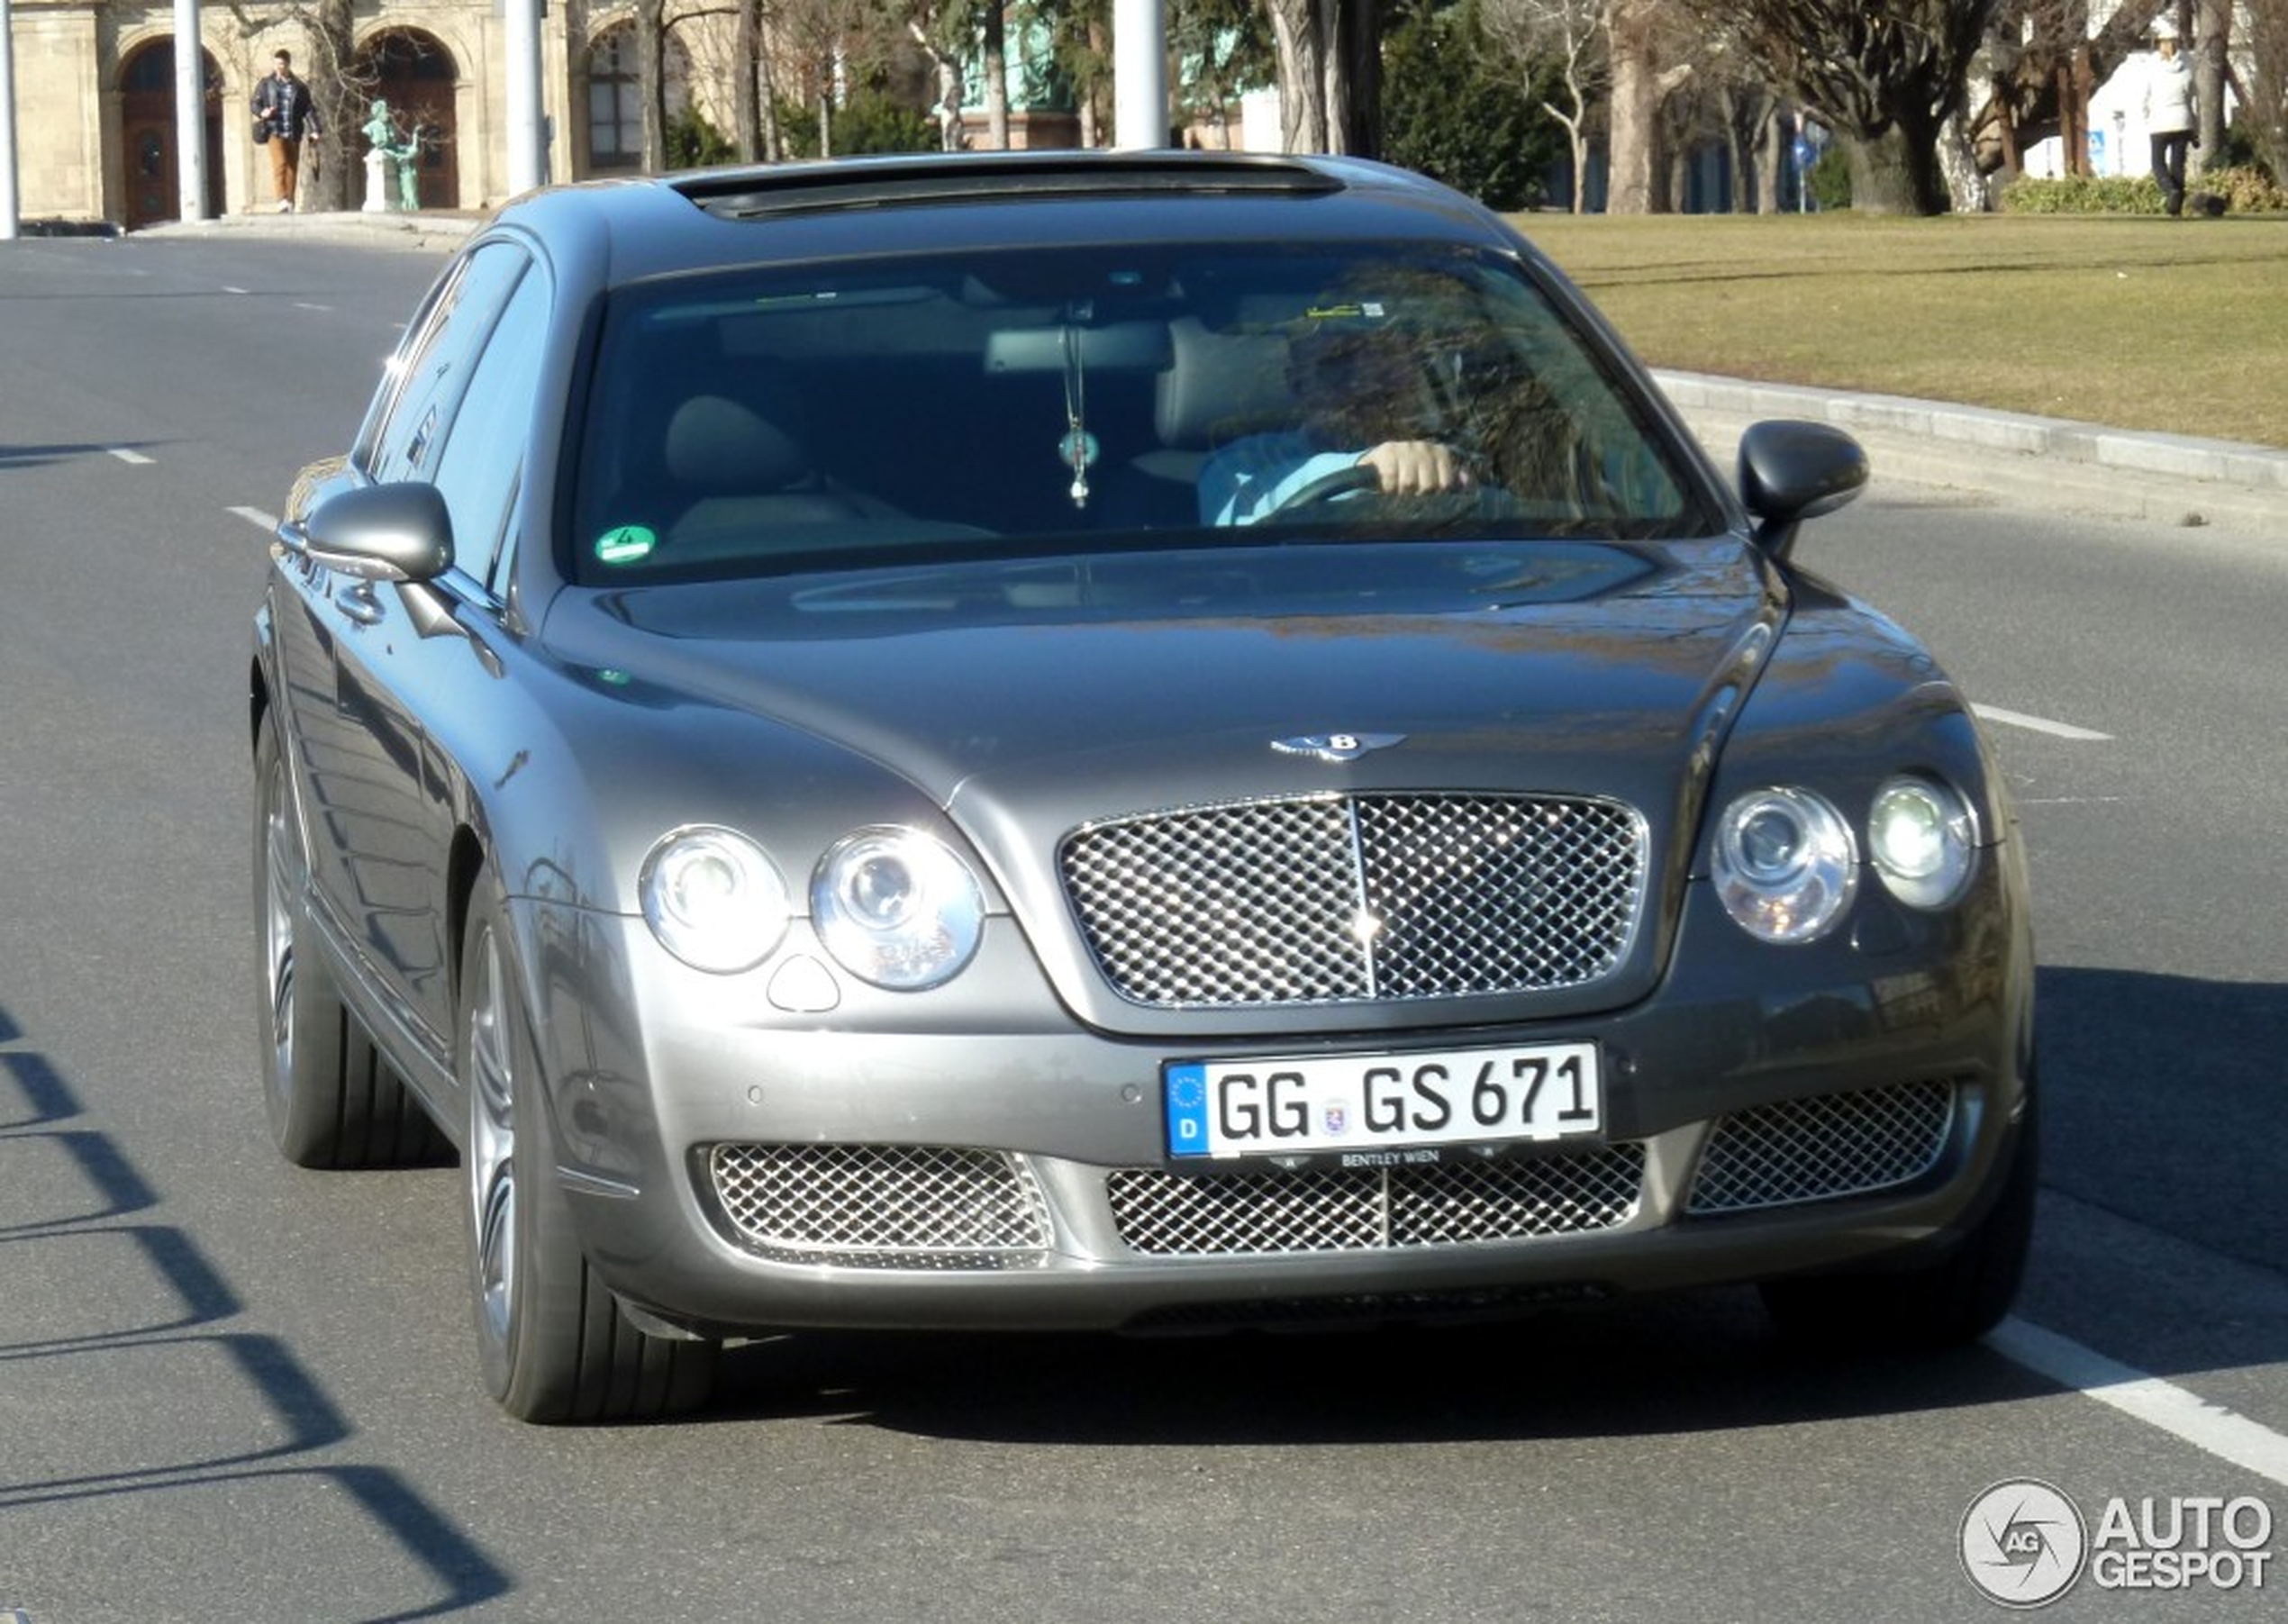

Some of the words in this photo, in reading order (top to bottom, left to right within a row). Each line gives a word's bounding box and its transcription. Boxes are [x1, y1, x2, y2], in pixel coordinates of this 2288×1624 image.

[617, 528, 633, 543] 4
[1218, 1071, 1309, 1139] GG
[1363, 1064, 1452, 1132] GS
[1471, 1055, 1593, 1127] 671
[1180, 1119, 1198, 1139] D
[1341, 1152, 1401, 1167] BENTLEY
[1403, 1149, 1440, 1164] WIEN
